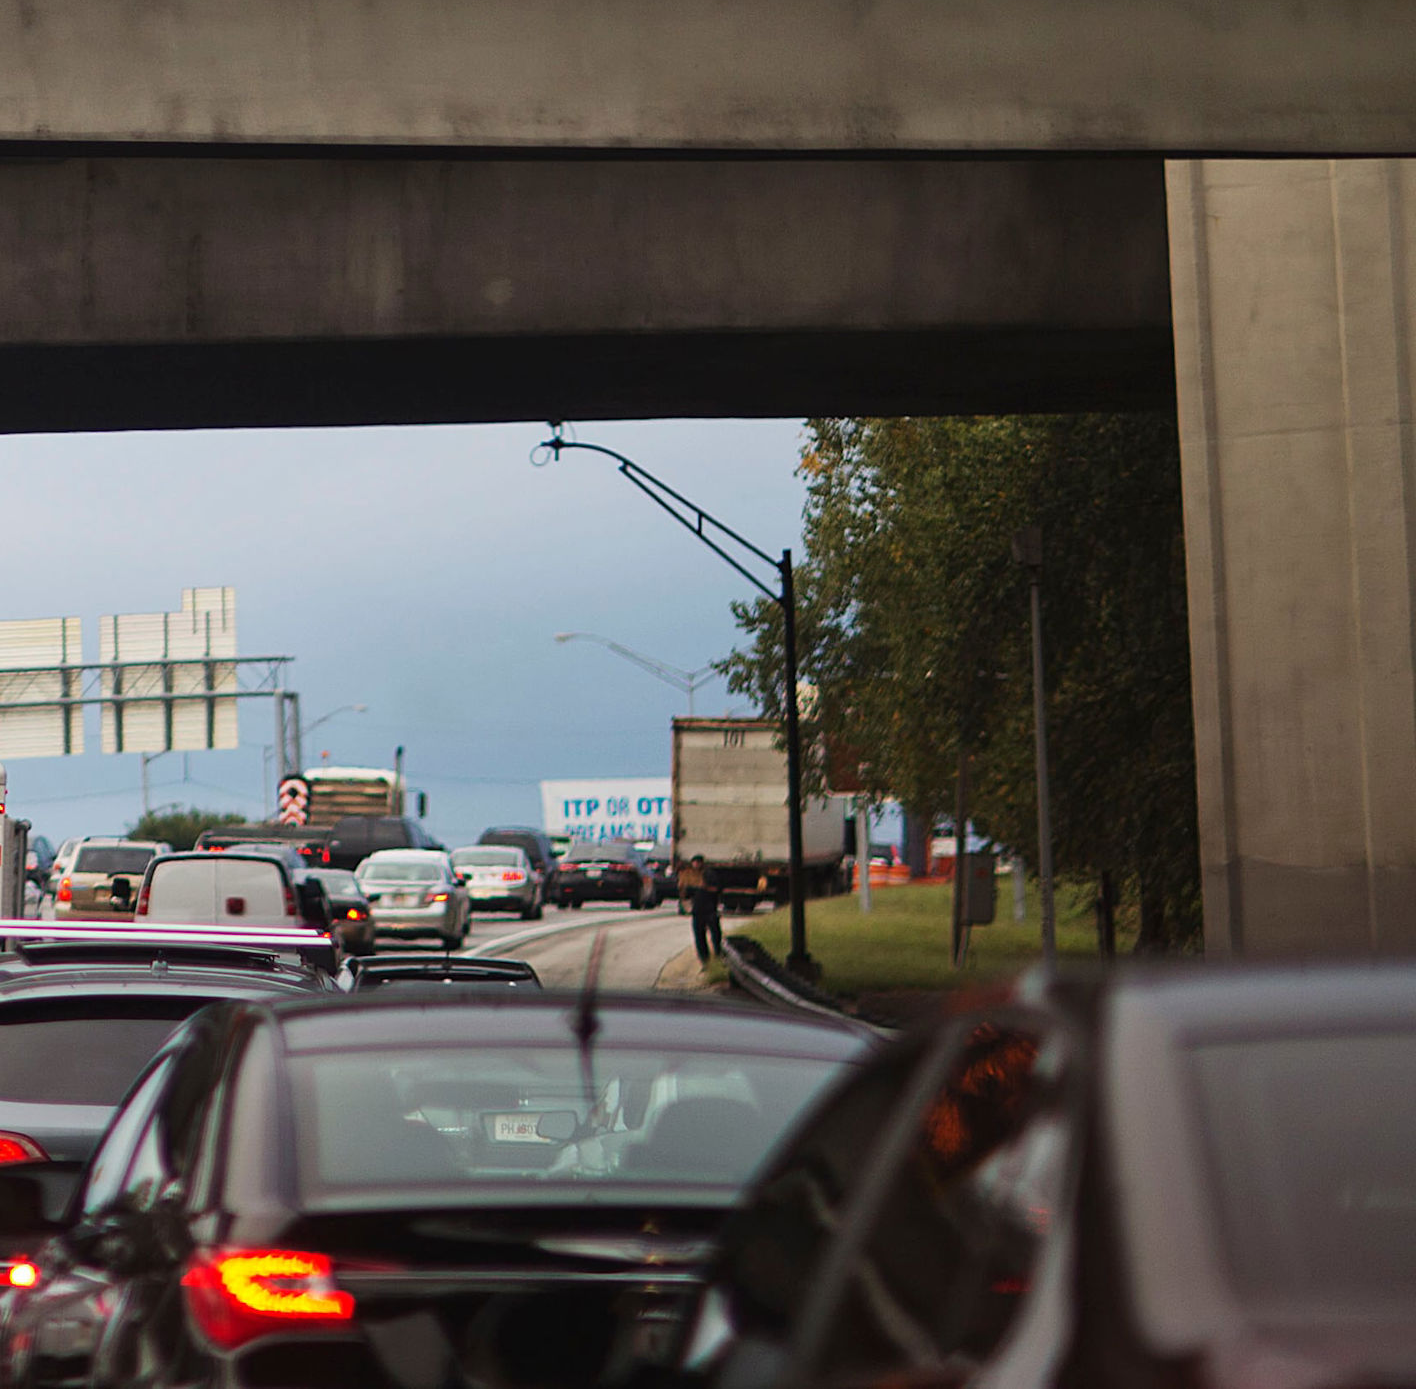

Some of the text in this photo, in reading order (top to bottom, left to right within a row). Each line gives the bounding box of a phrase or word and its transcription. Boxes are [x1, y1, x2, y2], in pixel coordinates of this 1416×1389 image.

[563, 796, 672, 819] ITP OR OT
